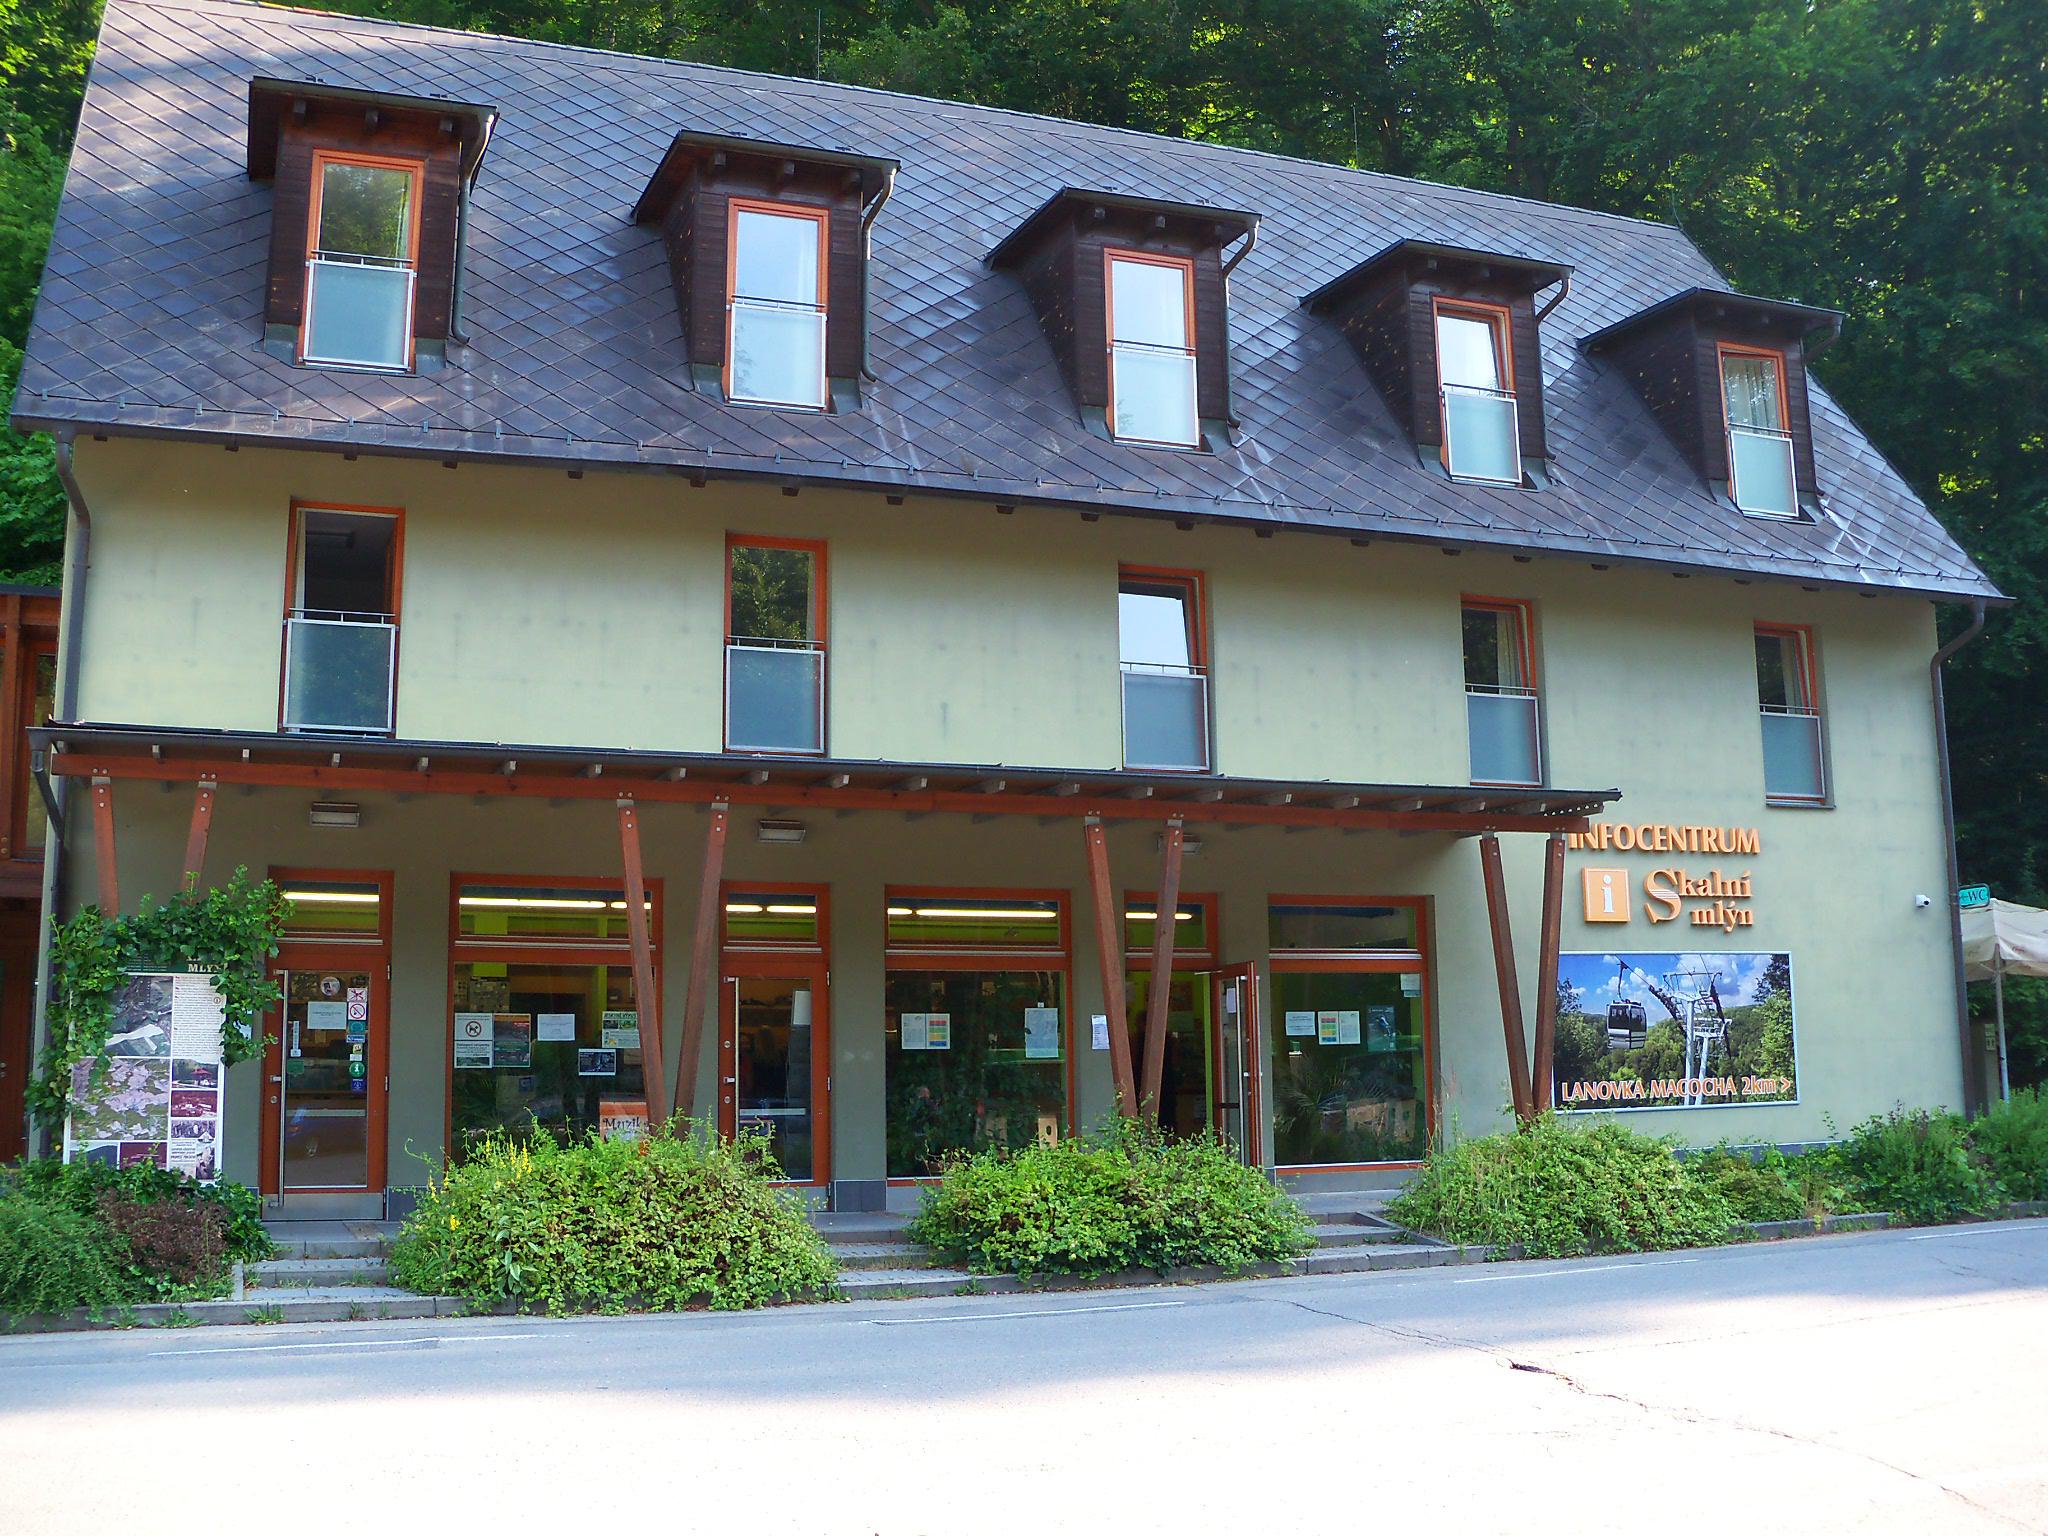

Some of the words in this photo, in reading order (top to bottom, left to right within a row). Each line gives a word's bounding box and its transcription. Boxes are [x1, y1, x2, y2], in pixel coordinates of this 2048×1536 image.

[1568, 823, 1761, 854] INFOCENTRUM
[1643, 868, 1752, 924] Skalní
[1967, 889, 1985, 902] WC
[1690, 899, 1754, 933] mlýn
[1562, 1079, 1646, 1101] LANOVKA
[1650, 1075, 1736, 1099] MACOCHA
[1741, 1074, 1776, 1095] 2km
